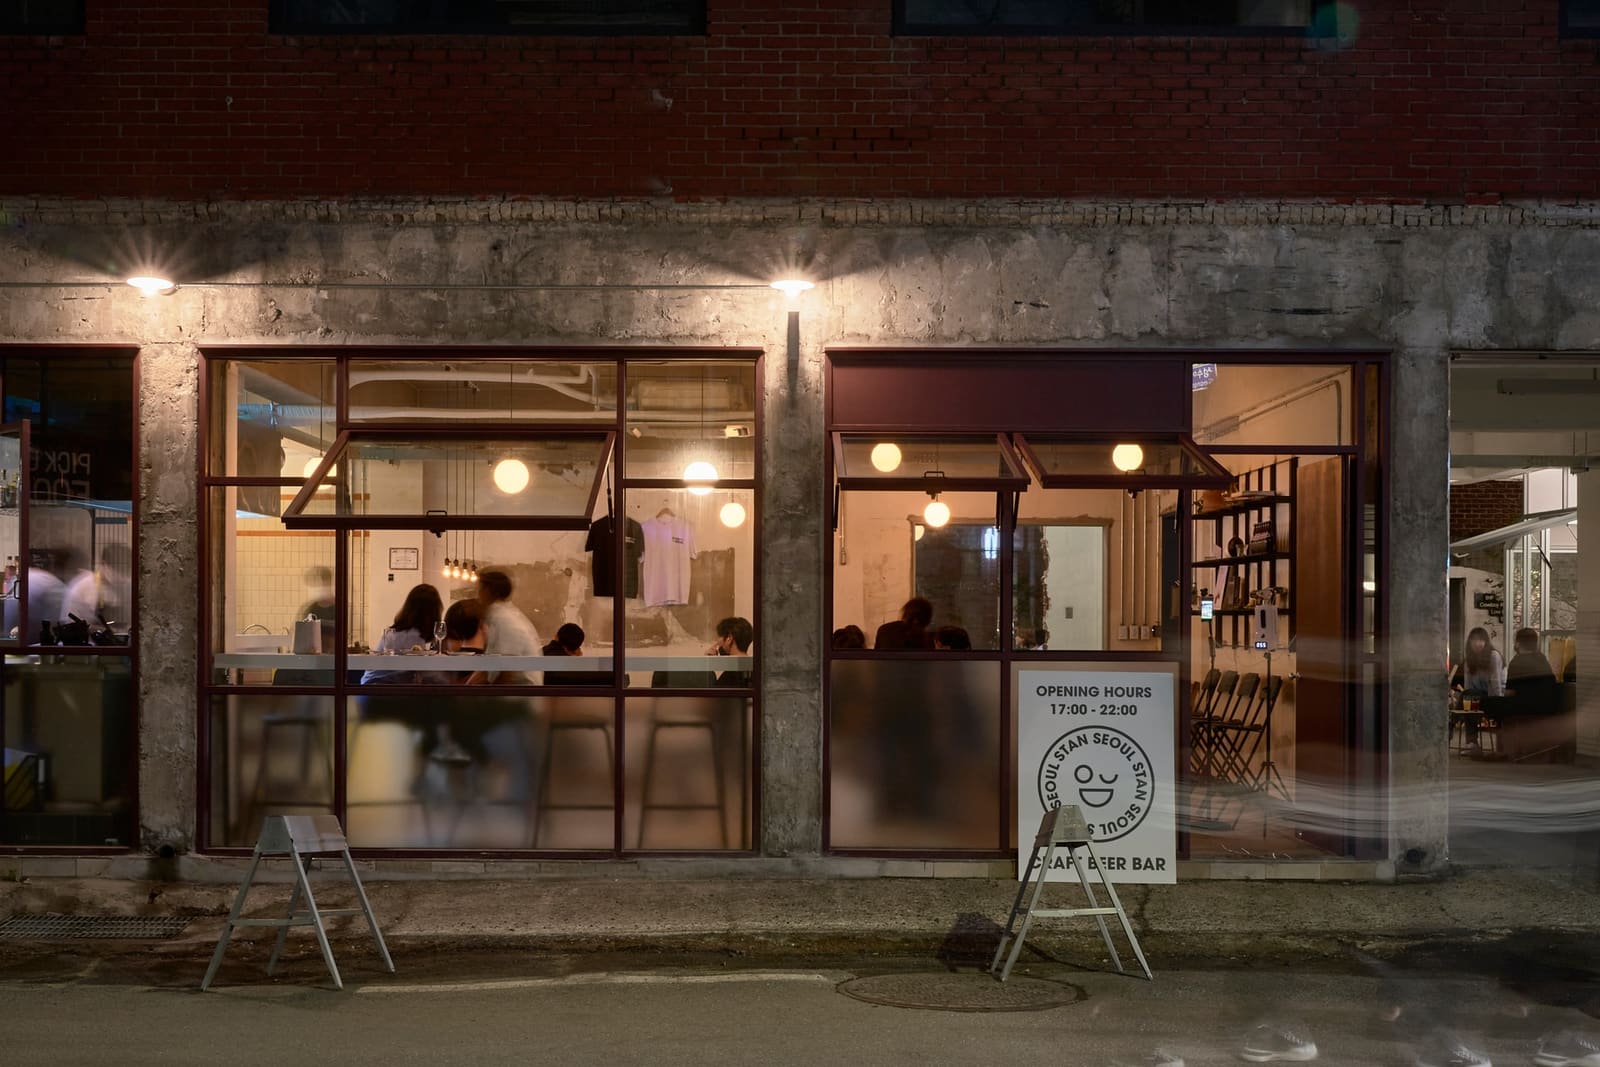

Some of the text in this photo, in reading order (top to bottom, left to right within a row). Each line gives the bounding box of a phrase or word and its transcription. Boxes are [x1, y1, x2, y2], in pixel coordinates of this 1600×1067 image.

[1036, 685, 1152, 698] OPENING HOURS
[1050, 704, 1087, 715] 17:00
[1099, 704, 1137, 716] 22:00
[1045, 732, 1148, 835] SEOUL STAN SEOUL STAN SEOUL
[1132, 857, 1166, 871] BAR
